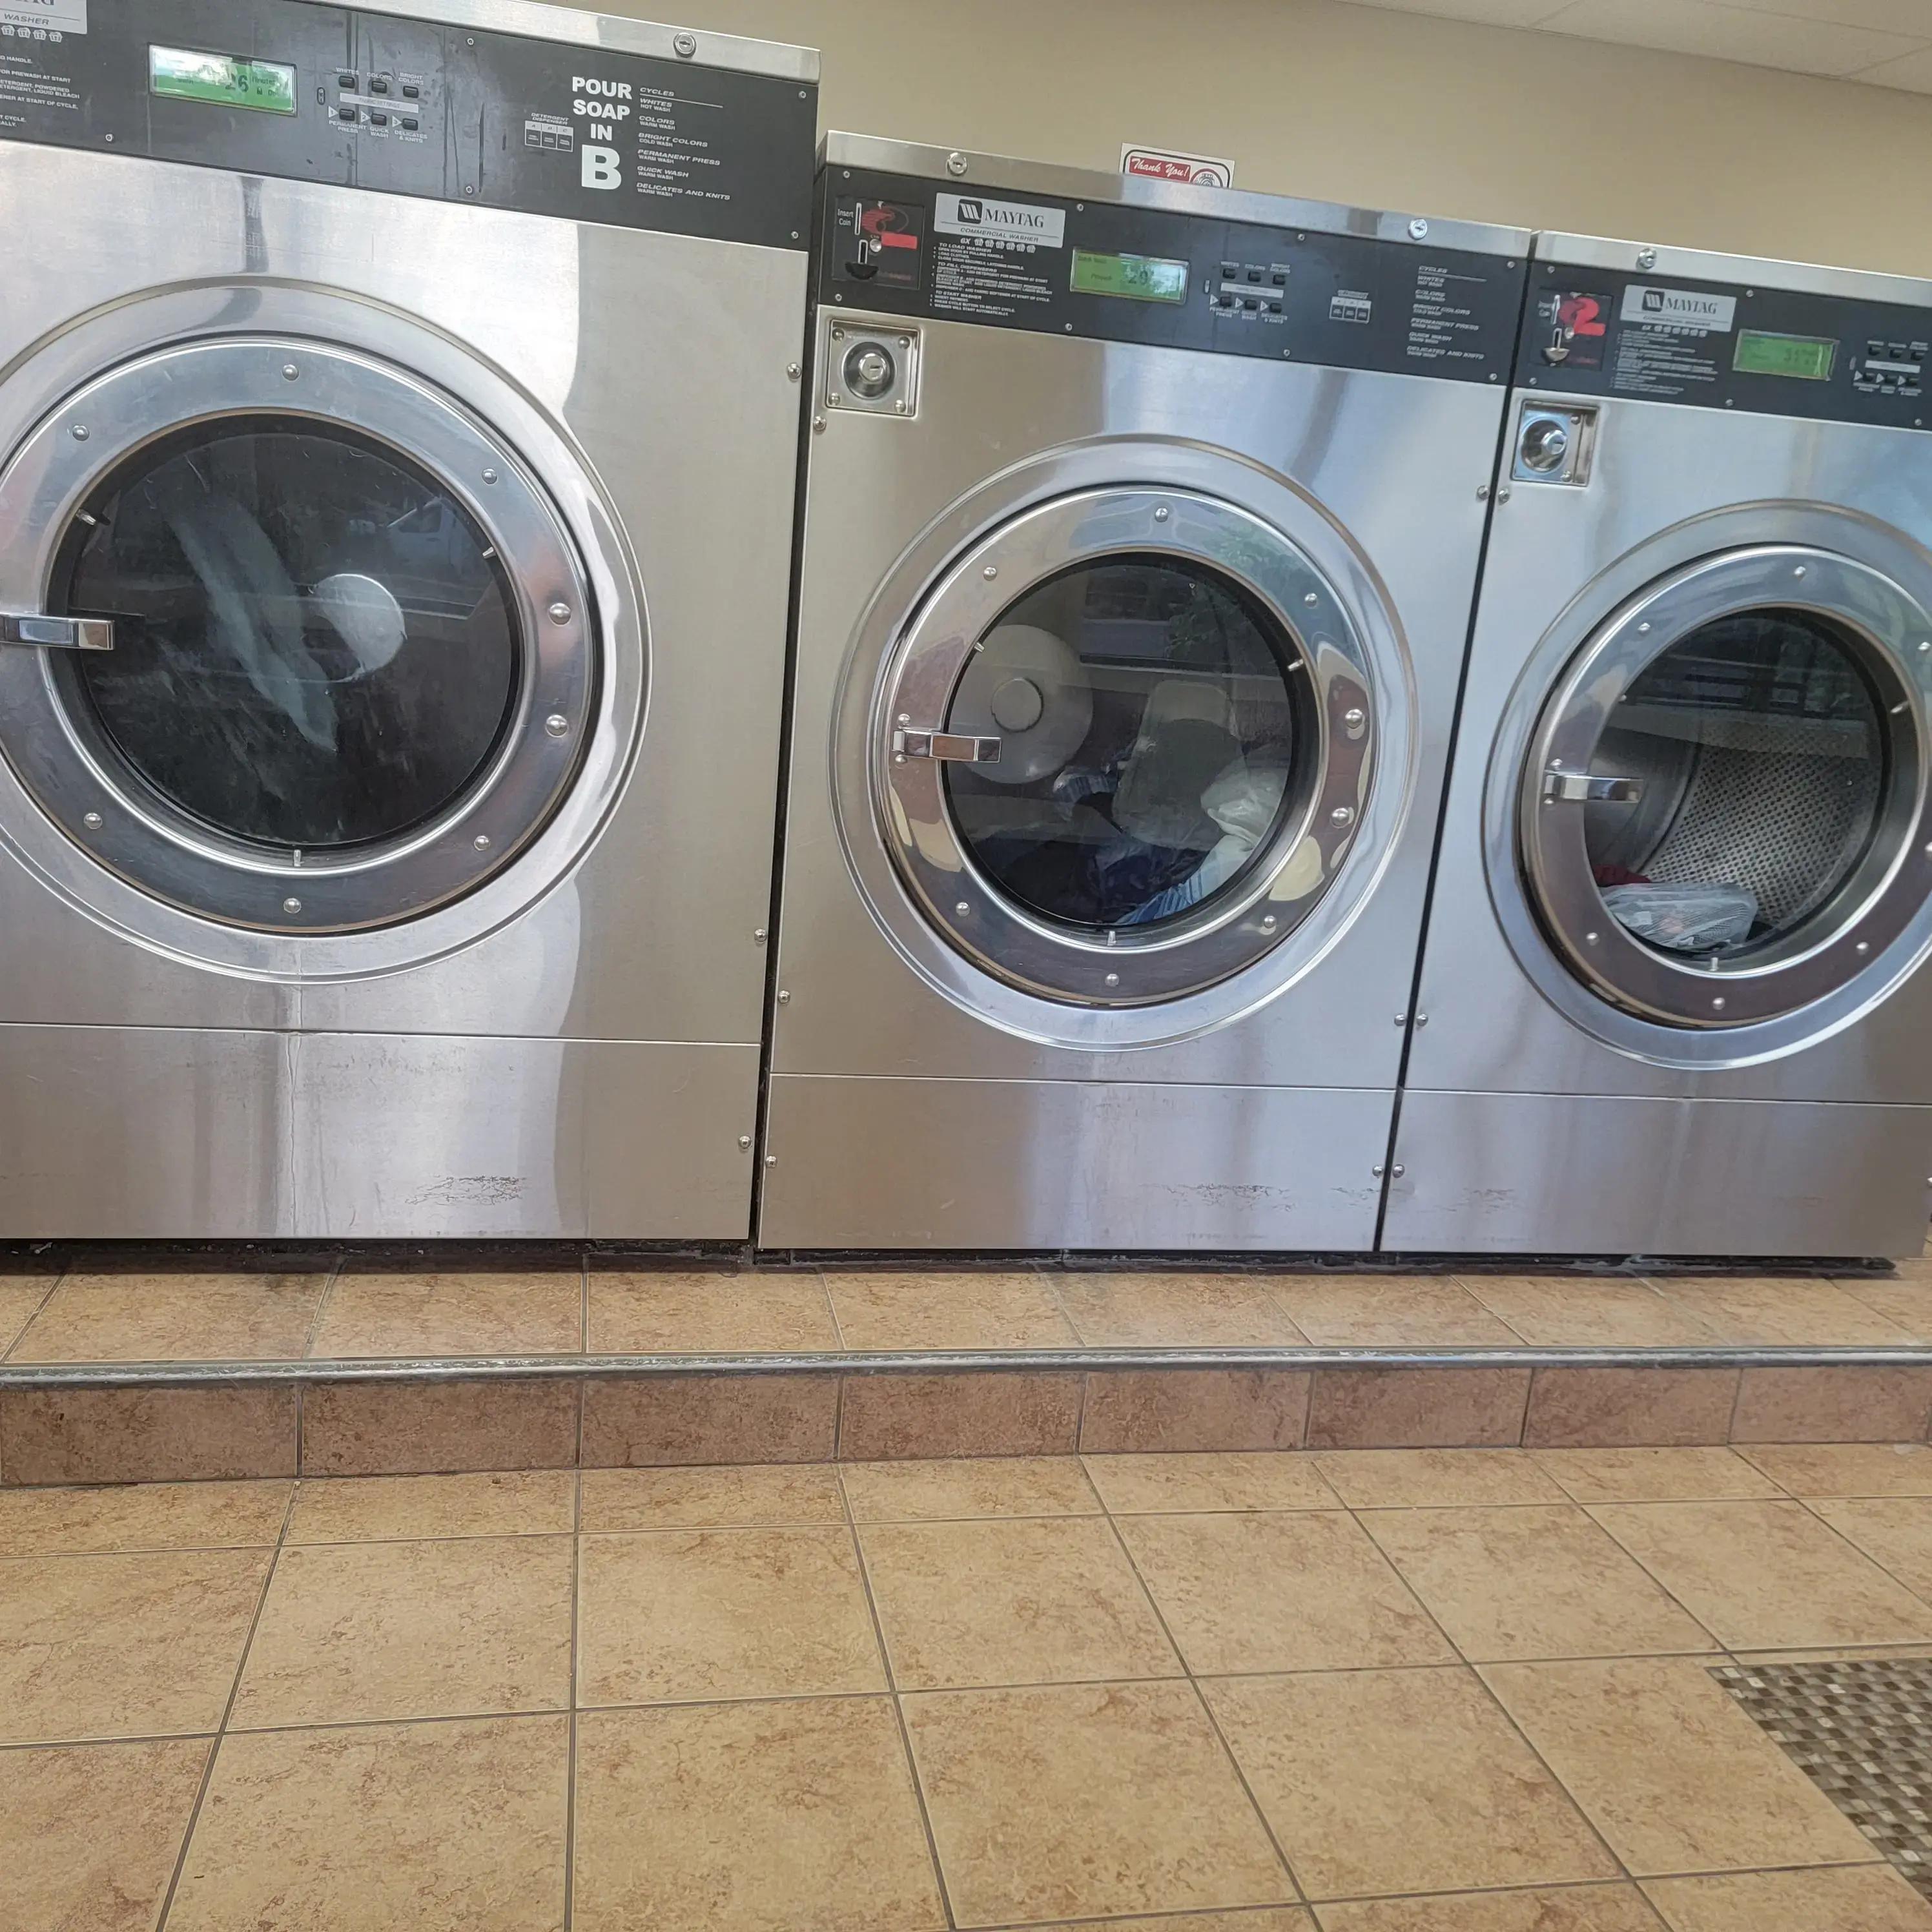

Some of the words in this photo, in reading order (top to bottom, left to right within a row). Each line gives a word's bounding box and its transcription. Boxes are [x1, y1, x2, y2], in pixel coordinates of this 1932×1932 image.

[4, 13, 49, 25] WASHER
[0, 79, 34, 88] ETERGENT,
[35, 84, 70, 92] POWDERED
[398, 77, 424, 85] COLORS
[572, 76, 632, 99] POUR
[640, 87, 674, 96] CYCLES
[640, 98, 672, 107] WHITES
[573, 99, 630, 120] SOAP
[531, 112, 570, 121] DETERGENT
[532, 117, 568, 125] DISPENSER
[639, 116, 675, 125] COLORS
[329, 119, 367, 130] PERMANENT
[395, 130, 427, 139] DELICATES
[590, 123, 612, 141] IN
[638, 132, 671, 141] BRIGHT
[672, 138, 708, 147] COLORS
[637, 149, 691, 161] PERMANENT
[692, 157, 721, 165] PRESS
[581, 145, 622, 190] B
[664, 169, 689, 178] WASH
[1132, 158, 1162, 172] Thank
[1166, 163, 1189, 177] You!
[637, 182, 683, 194] DELICATES
[838, 209, 854, 218] Insert
[985, 209, 1044, 227] MAYTAG
[960, 228, 1007, 238] COMMERCIAL
[1009, 234, 1038, 243] WASHER
[1666, 298, 1717, 314] MAYTAG
